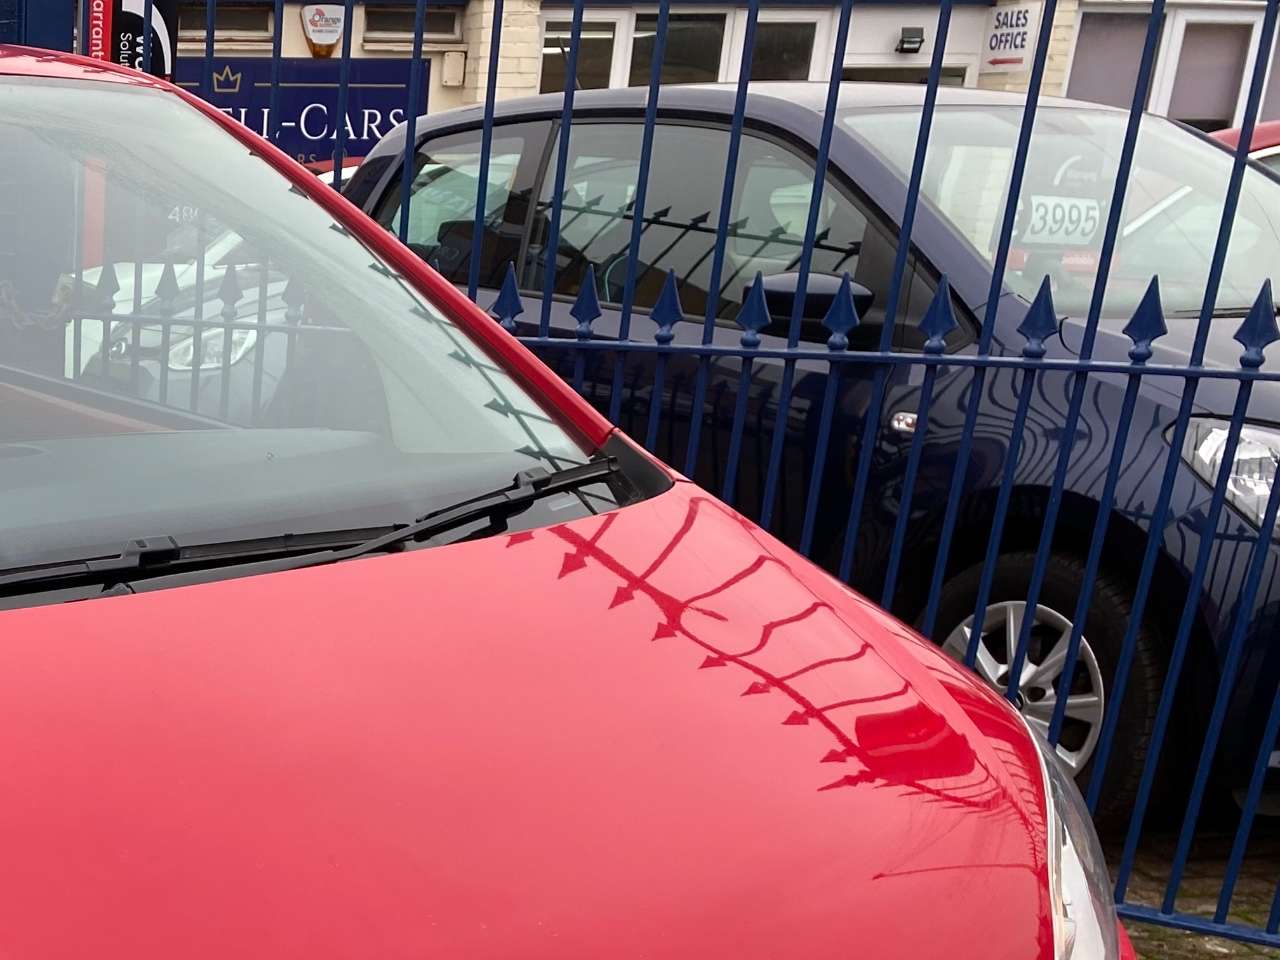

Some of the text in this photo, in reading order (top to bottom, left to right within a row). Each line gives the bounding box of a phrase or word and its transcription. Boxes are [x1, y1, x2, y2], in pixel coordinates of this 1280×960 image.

[994, 9, 1029, 29] SALES
[989, 31, 1028, 50] OFFICE
[1030, 202, 1098, 238] 3995
